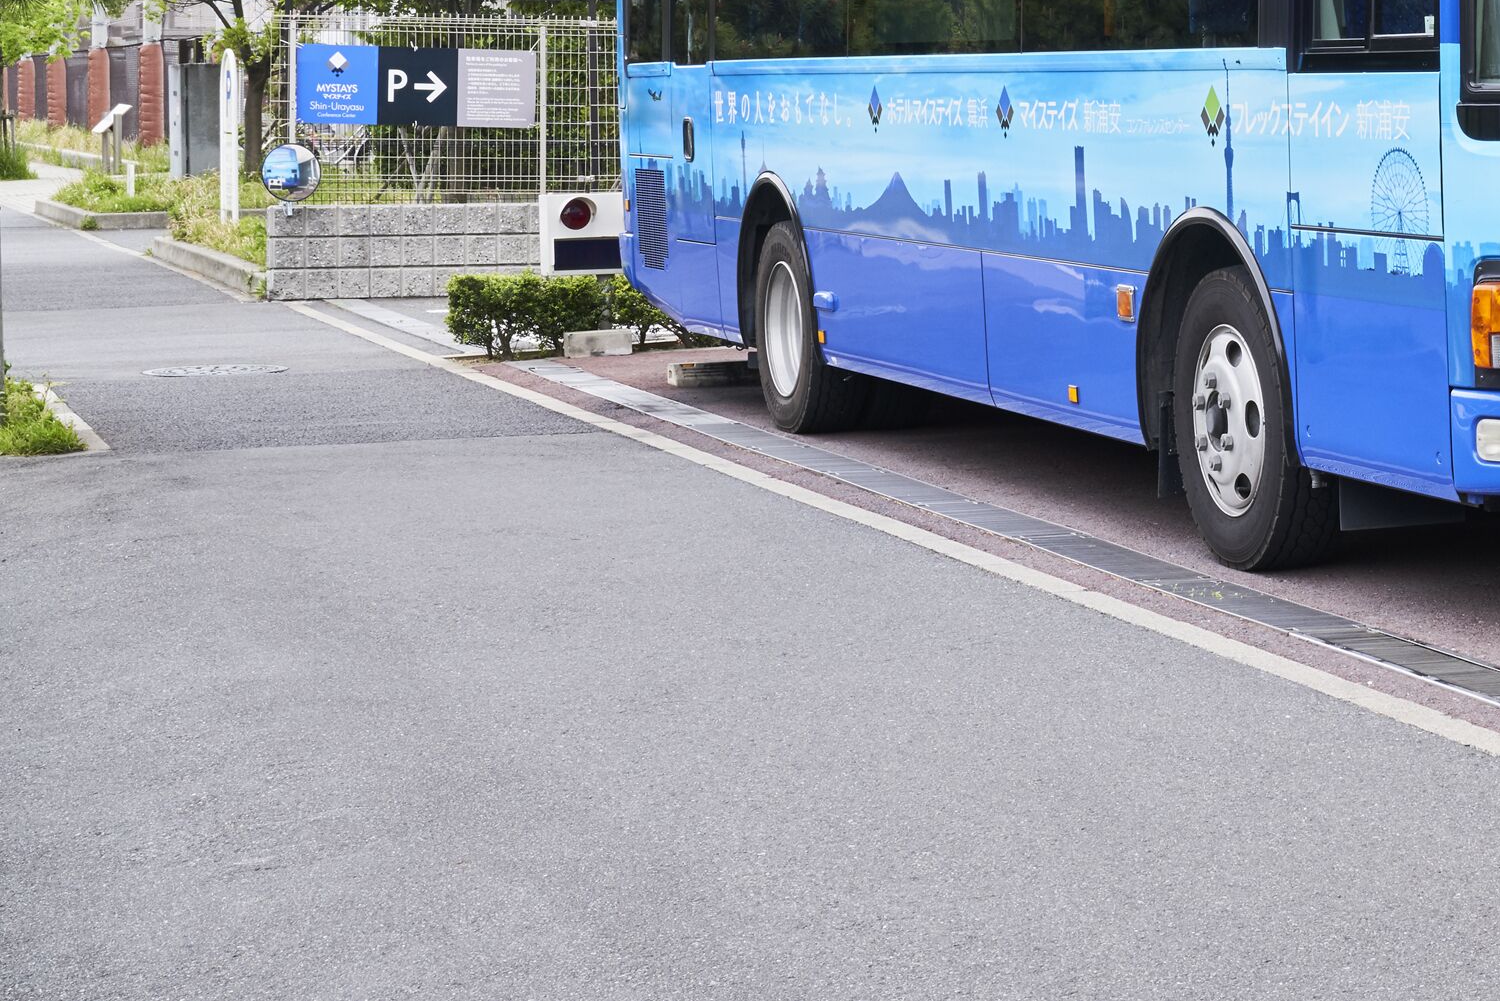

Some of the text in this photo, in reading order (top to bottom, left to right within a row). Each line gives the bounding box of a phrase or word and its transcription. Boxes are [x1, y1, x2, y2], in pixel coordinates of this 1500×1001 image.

[316, 83, 358, 93] MYSTAYS
[387, 69, 408, 103] P
[309, 100, 365, 113] Shin-Urayasu
[714, 90, 852, 128] 世界の人をおもてなし。
[887, 96, 963, 127] ホテルマイステイズ
[1019, 98, 1079, 131] マイステイズ
[1083, 99, 1122, 134] 新浦安
[1232, 99, 1411, 141] フレックステイイン 新浦安
